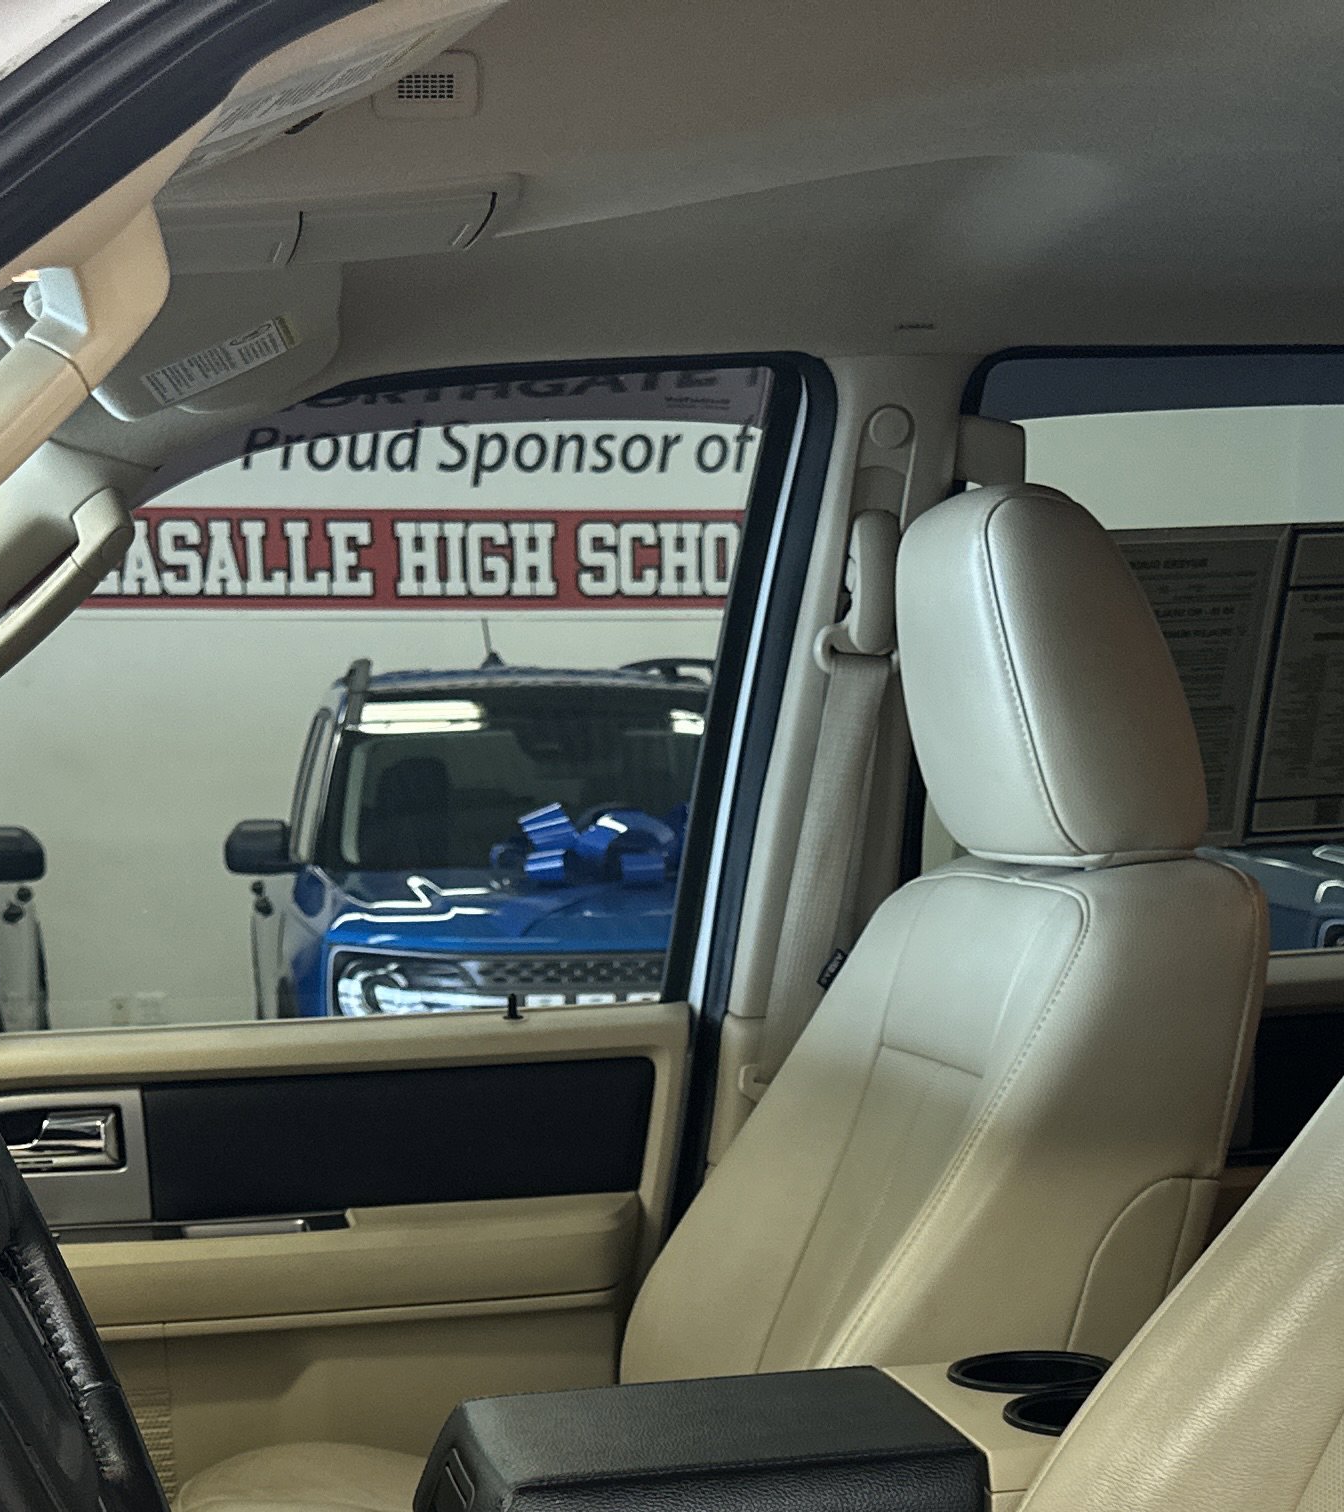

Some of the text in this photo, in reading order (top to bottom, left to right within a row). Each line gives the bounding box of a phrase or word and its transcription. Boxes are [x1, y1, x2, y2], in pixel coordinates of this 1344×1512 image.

[242, 414, 756, 489] Proud Sponsor of
[394, 521, 558, 598] HIGH
[576, 521, 743, 598] SCHO
